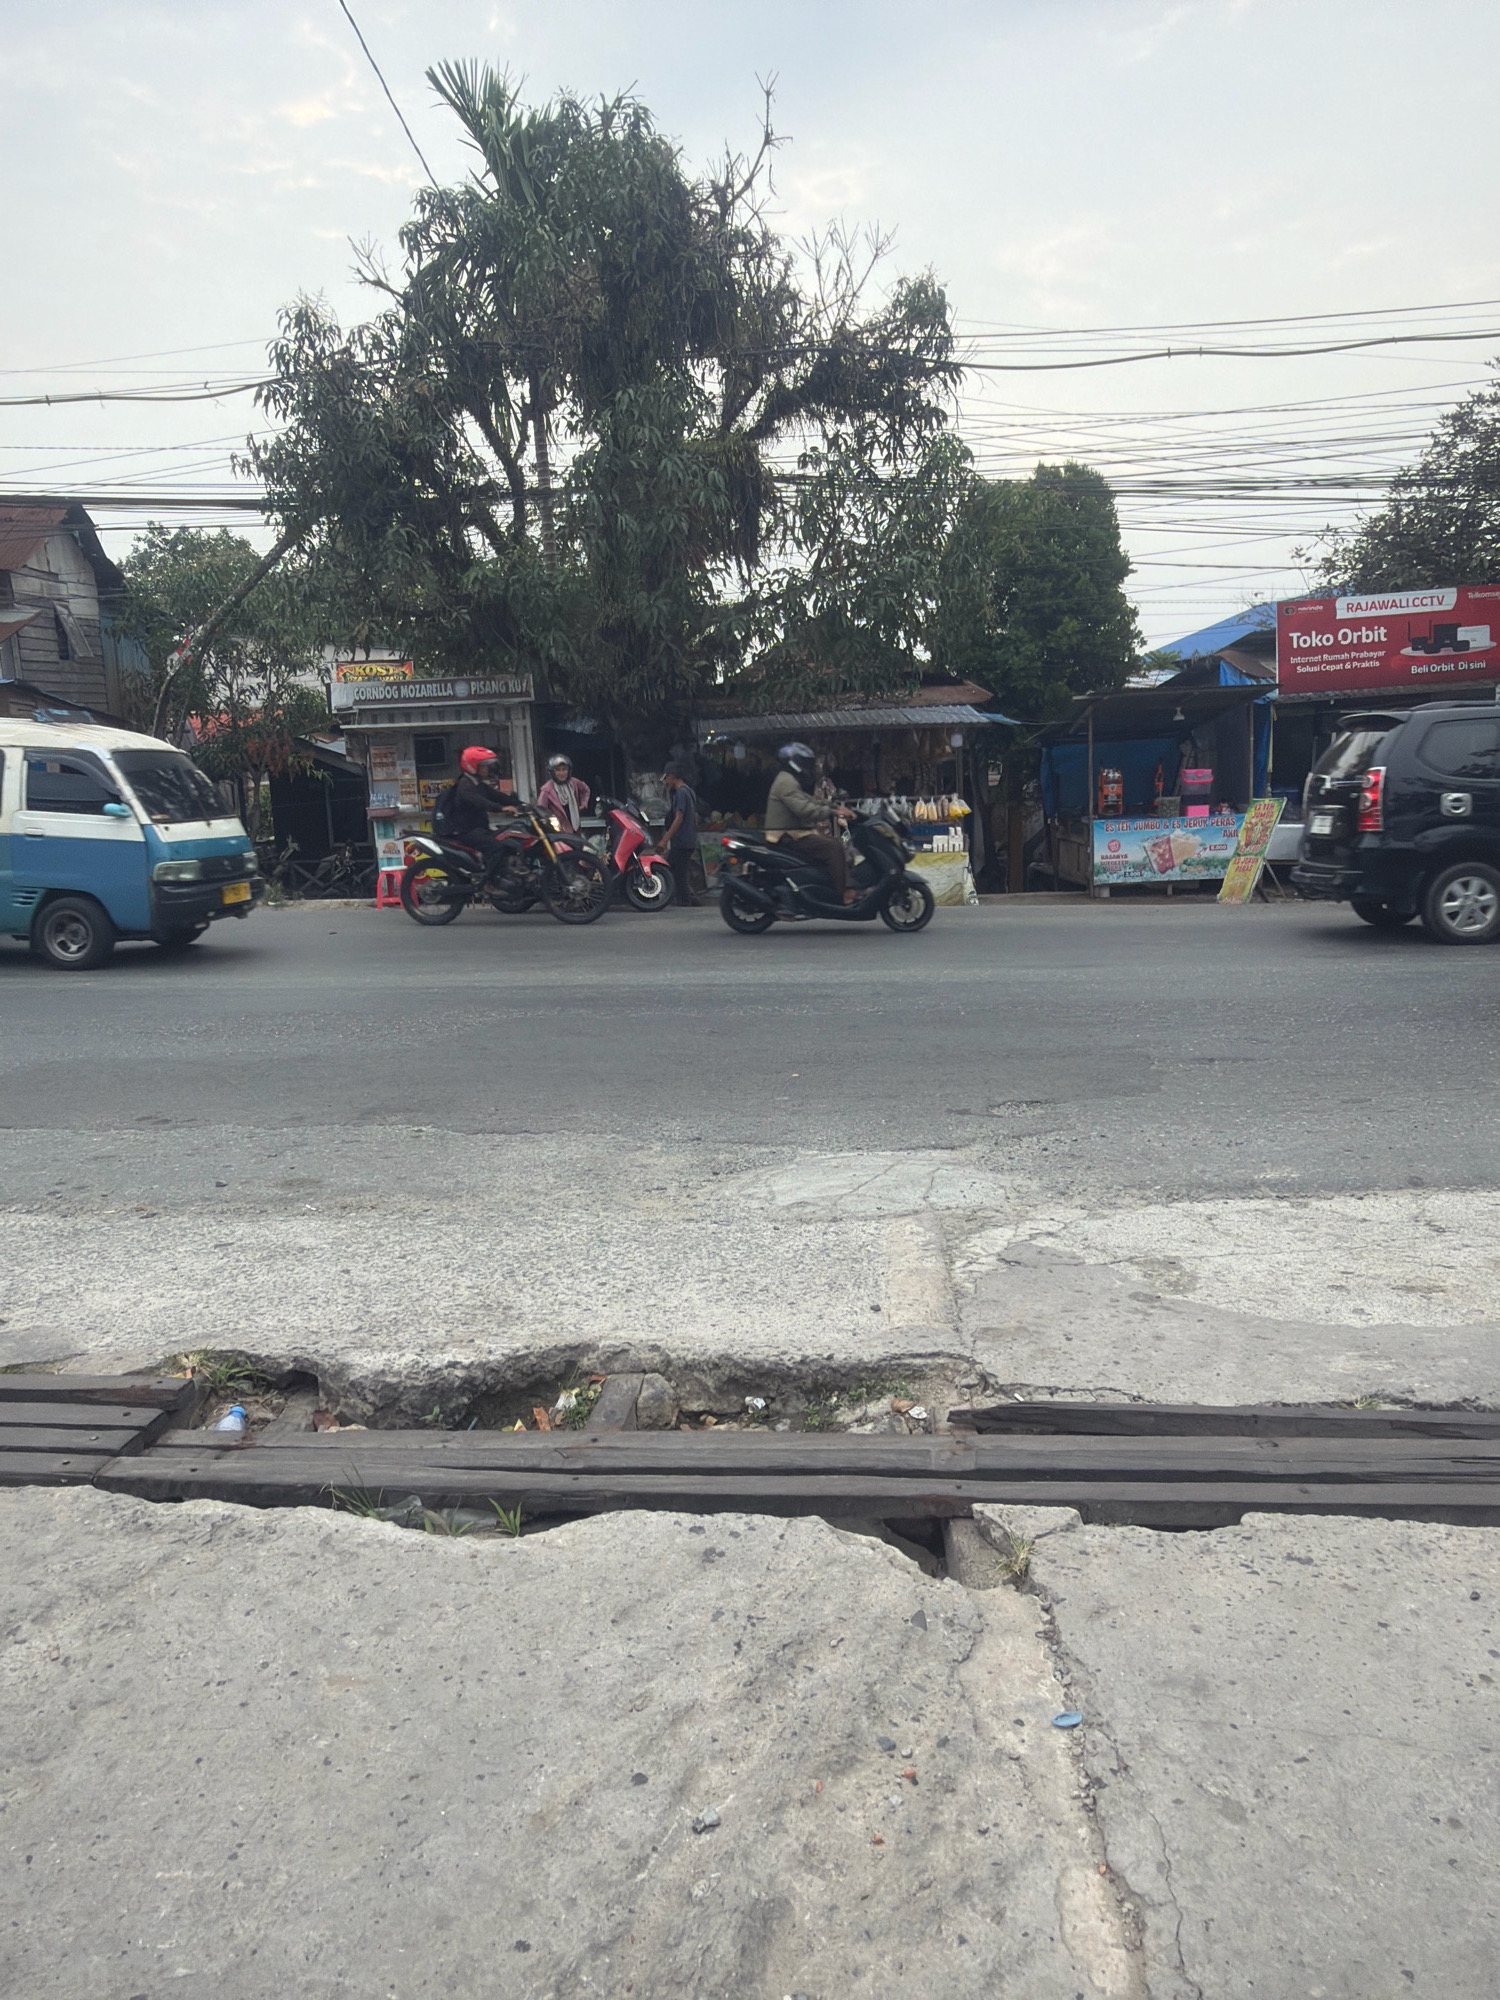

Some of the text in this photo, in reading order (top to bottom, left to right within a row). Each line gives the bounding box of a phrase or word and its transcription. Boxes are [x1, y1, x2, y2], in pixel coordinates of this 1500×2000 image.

[1346, 595, 1445, 613] RAJAWALI CCTV
[1289, 626, 1388, 649] Toko Orbit
[1290, 650, 1386, 664] Internet Rumah Prabayar
[353, 665, 394, 676] KOST
[1296, 660, 1379, 673] Solusi Cepat & Praktis
[1411, 660, 1486, 674] Beli Orbit Di sini
[354, 684, 398, 700] CORNDOG
[401, 682, 453, 698] MOZARELLA
[471, 680, 506, 695] PISANG
[1105, 817, 1235, 832] ES TEH JUMBO & ES JERUK PERAS
